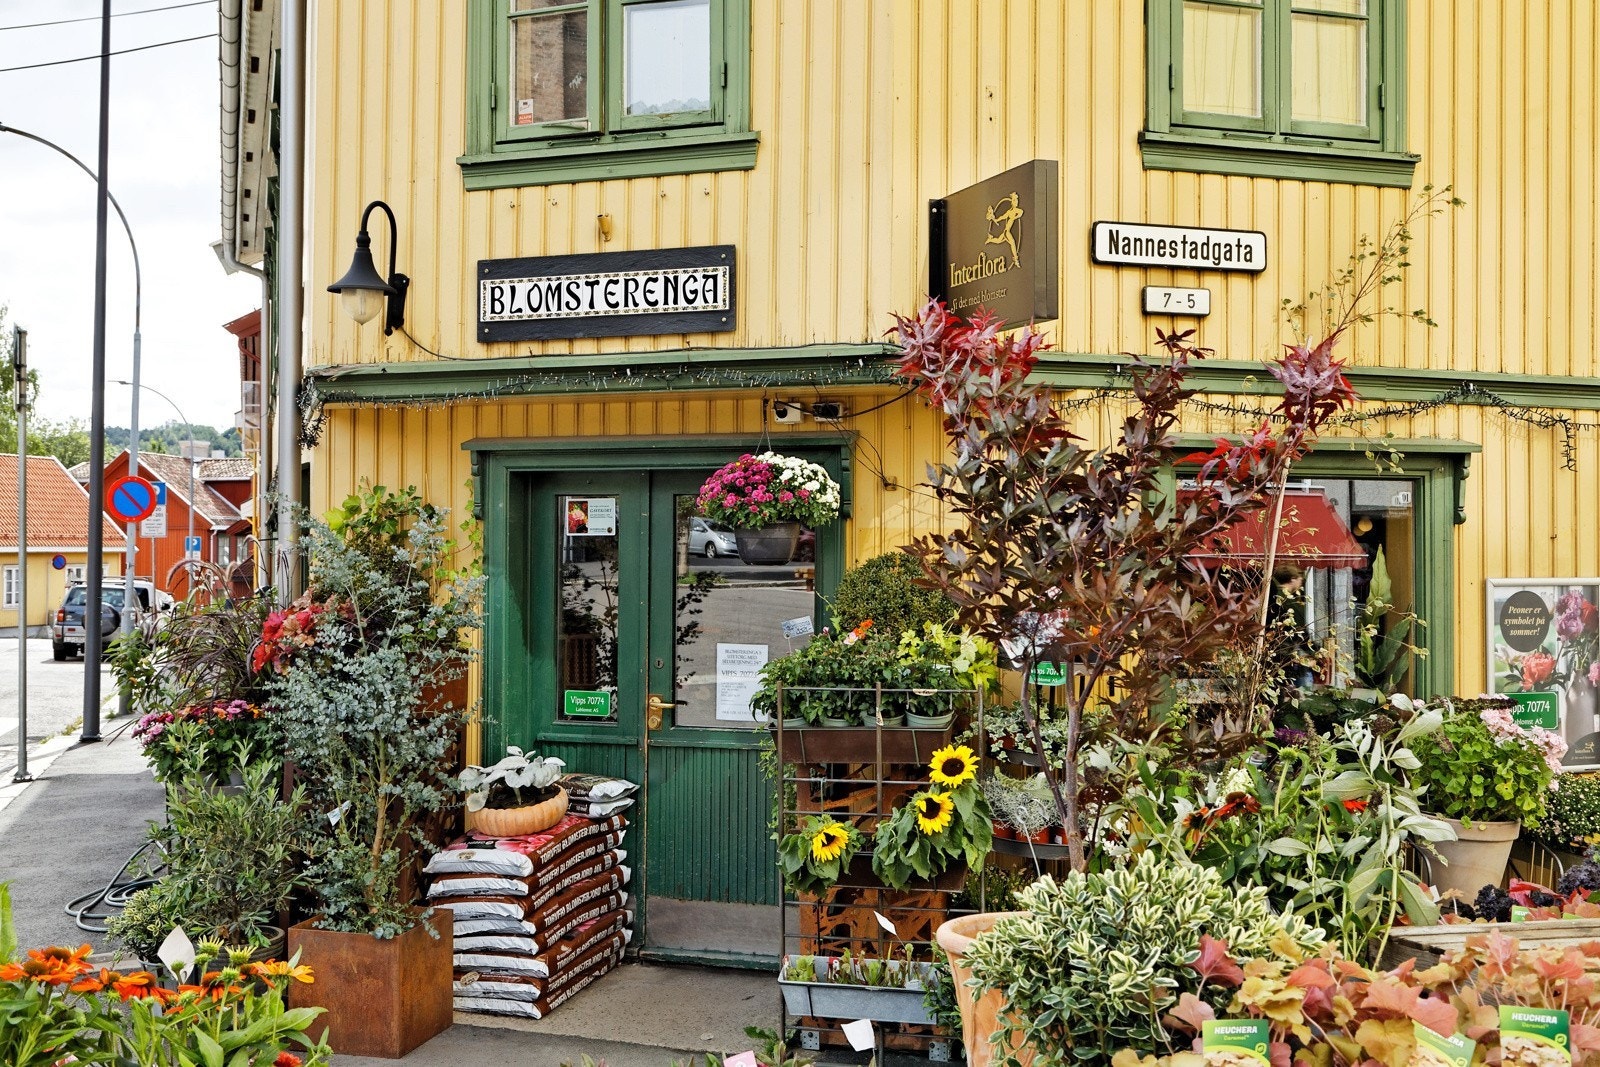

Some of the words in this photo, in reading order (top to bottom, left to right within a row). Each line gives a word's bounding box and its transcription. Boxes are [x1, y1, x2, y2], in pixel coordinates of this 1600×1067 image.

[1108, 229, 1253, 266] Nannestadgata
[950, 252, 1006, 288] Interflora
[490, 273, 719, 315] BLOMSTERENGA
[982, 288, 1008, 303] blomster
[1163, 292, 1172, 308] 7
[1187, 294, 1196, 308] 5
[1508, 606, 1533, 614] Peoner
[1504, 616, 1535, 626] symbolet
[1536, 616, 1546, 626] på
[1510, 628, 1540, 636] sommer!
[570, 696, 586, 705] Vipps
[587, 696, 605, 705] 70774
[1526, 700, 1550, 712] 70774
[540, 844, 562, 864] TORVFRI
[562, 824, 599, 851] BLOMSTERJORD
[600, 822, 609, 832] 40L
[538, 866, 560, 888] TORVFRI
[560, 846, 596, 872] BLOMSTERJORD
[596, 843, 605, 853] 40L
[534, 887, 555, 910] TORVFRI
[556, 867, 593, 893] BLOMSTERJORD
[594, 864, 602, 874] 40L
[544, 905, 566, 928] TORVFRI
[566, 887, 602, 912] BLOMSTERJORD
[602, 883, 610, 894] 40L
[600, 904, 608, 914] 40L
[1511, 1012, 1558, 1024] HEUCHERA
[1214, 1026, 1258, 1034] HEUCHERA
